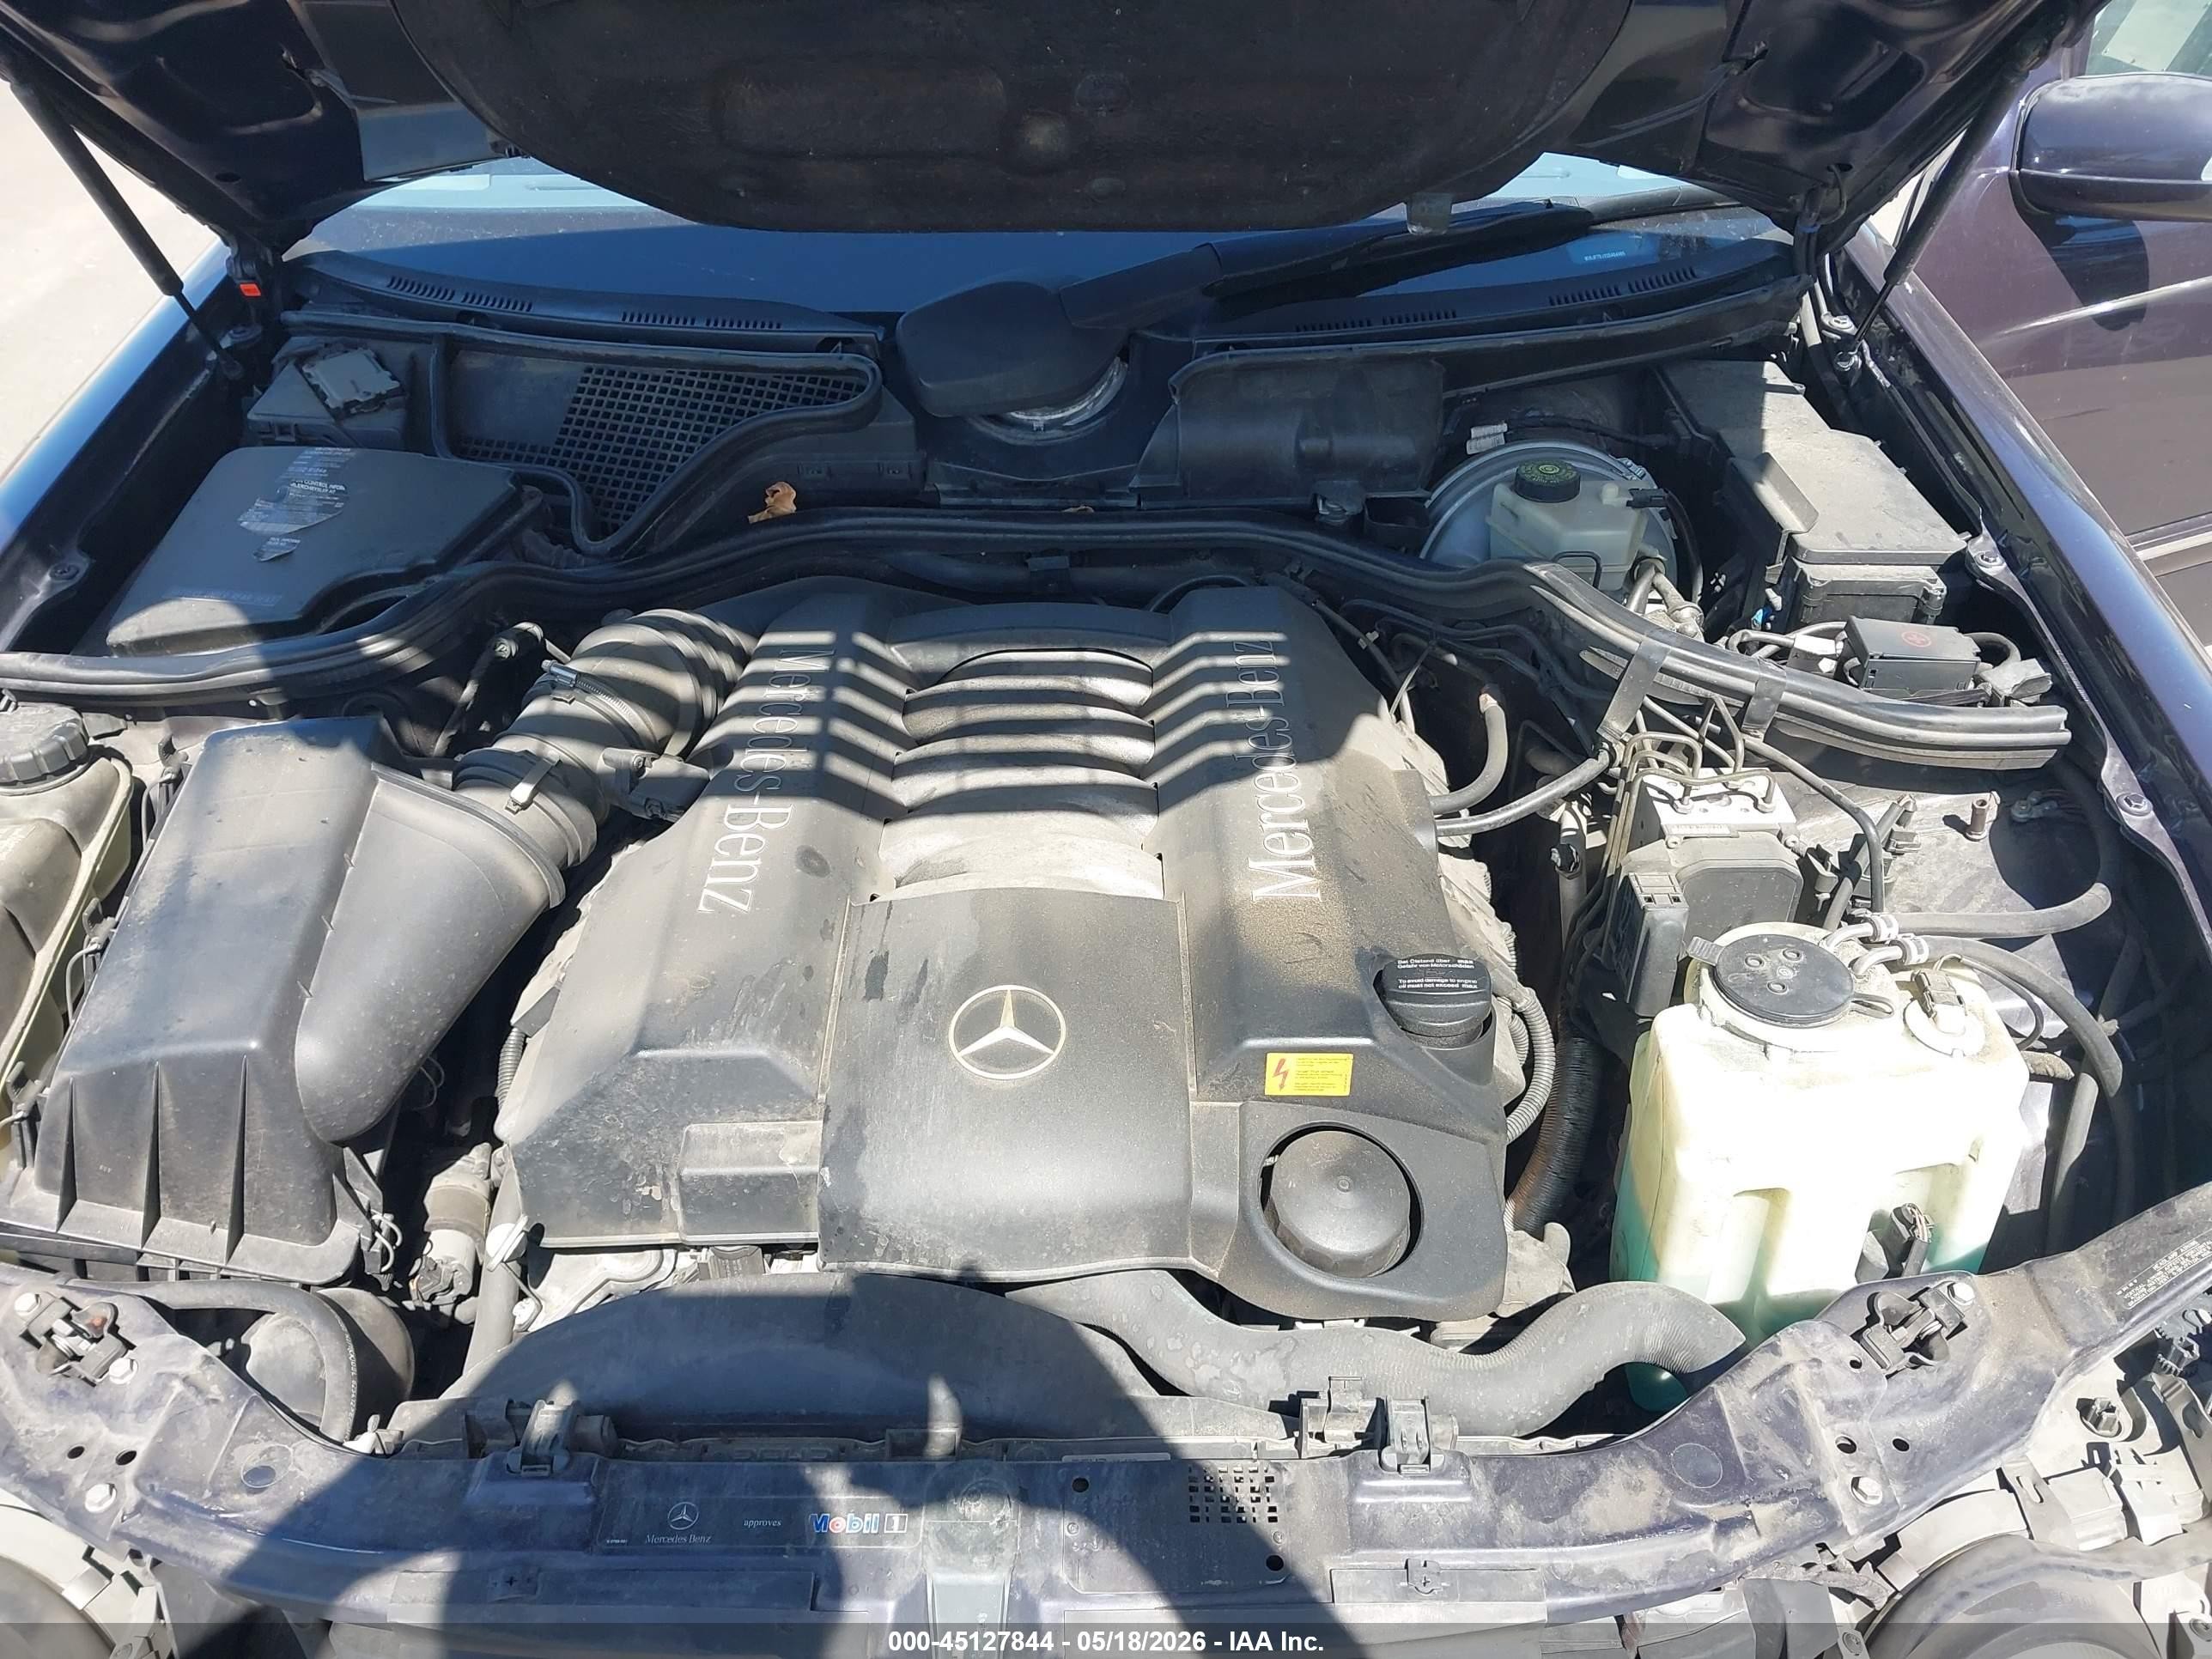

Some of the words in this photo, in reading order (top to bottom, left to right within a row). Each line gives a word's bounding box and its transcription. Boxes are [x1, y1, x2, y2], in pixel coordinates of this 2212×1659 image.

[698, 648, 835, 914] Mercedes-Benz
[1226, 640, 1322, 902] Mercedes-Benz
[645, 1533, 688, 1544] Mercedes
[689, 1533, 712, 1544] Benz
[744, 1517, 782, 1528] approves
[811, 1513, 879, 1534] Mobil
